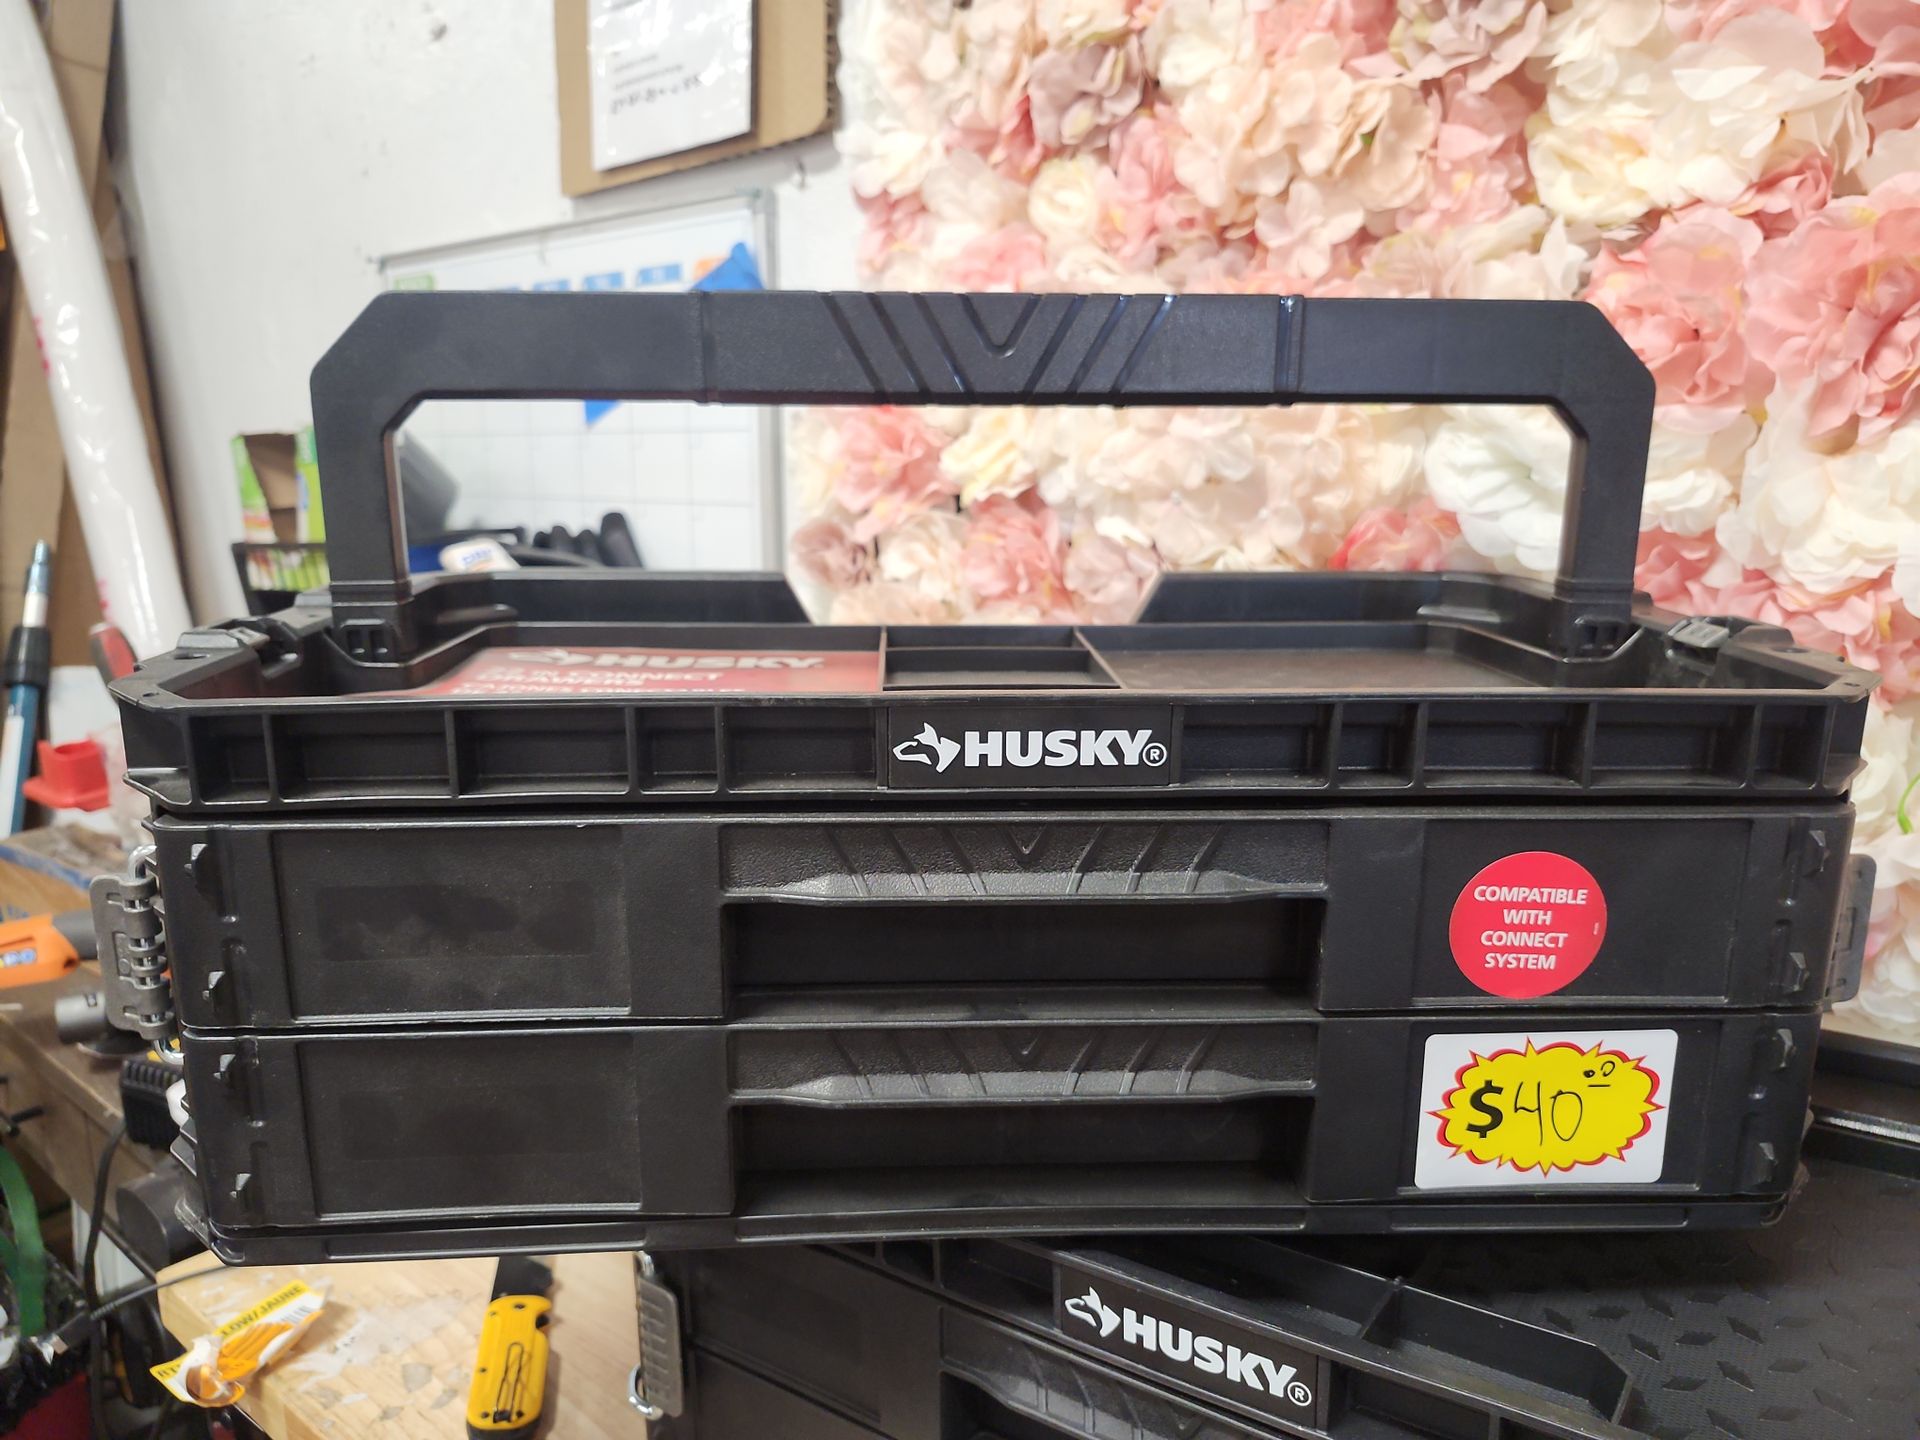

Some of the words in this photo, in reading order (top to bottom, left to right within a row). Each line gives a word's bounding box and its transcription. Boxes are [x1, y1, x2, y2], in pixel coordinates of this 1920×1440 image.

[594, 655, 822, 669] HUSKY
[566, 670, 724, 681] CONNECT
[1473, 886, 1588, 905] COMPATIBLE
[1503, 908, 1552, 925] WITH
[1480, 931, 1568, 948] CONNECT
[1484, 953, 1556, 969] SYSTEM
